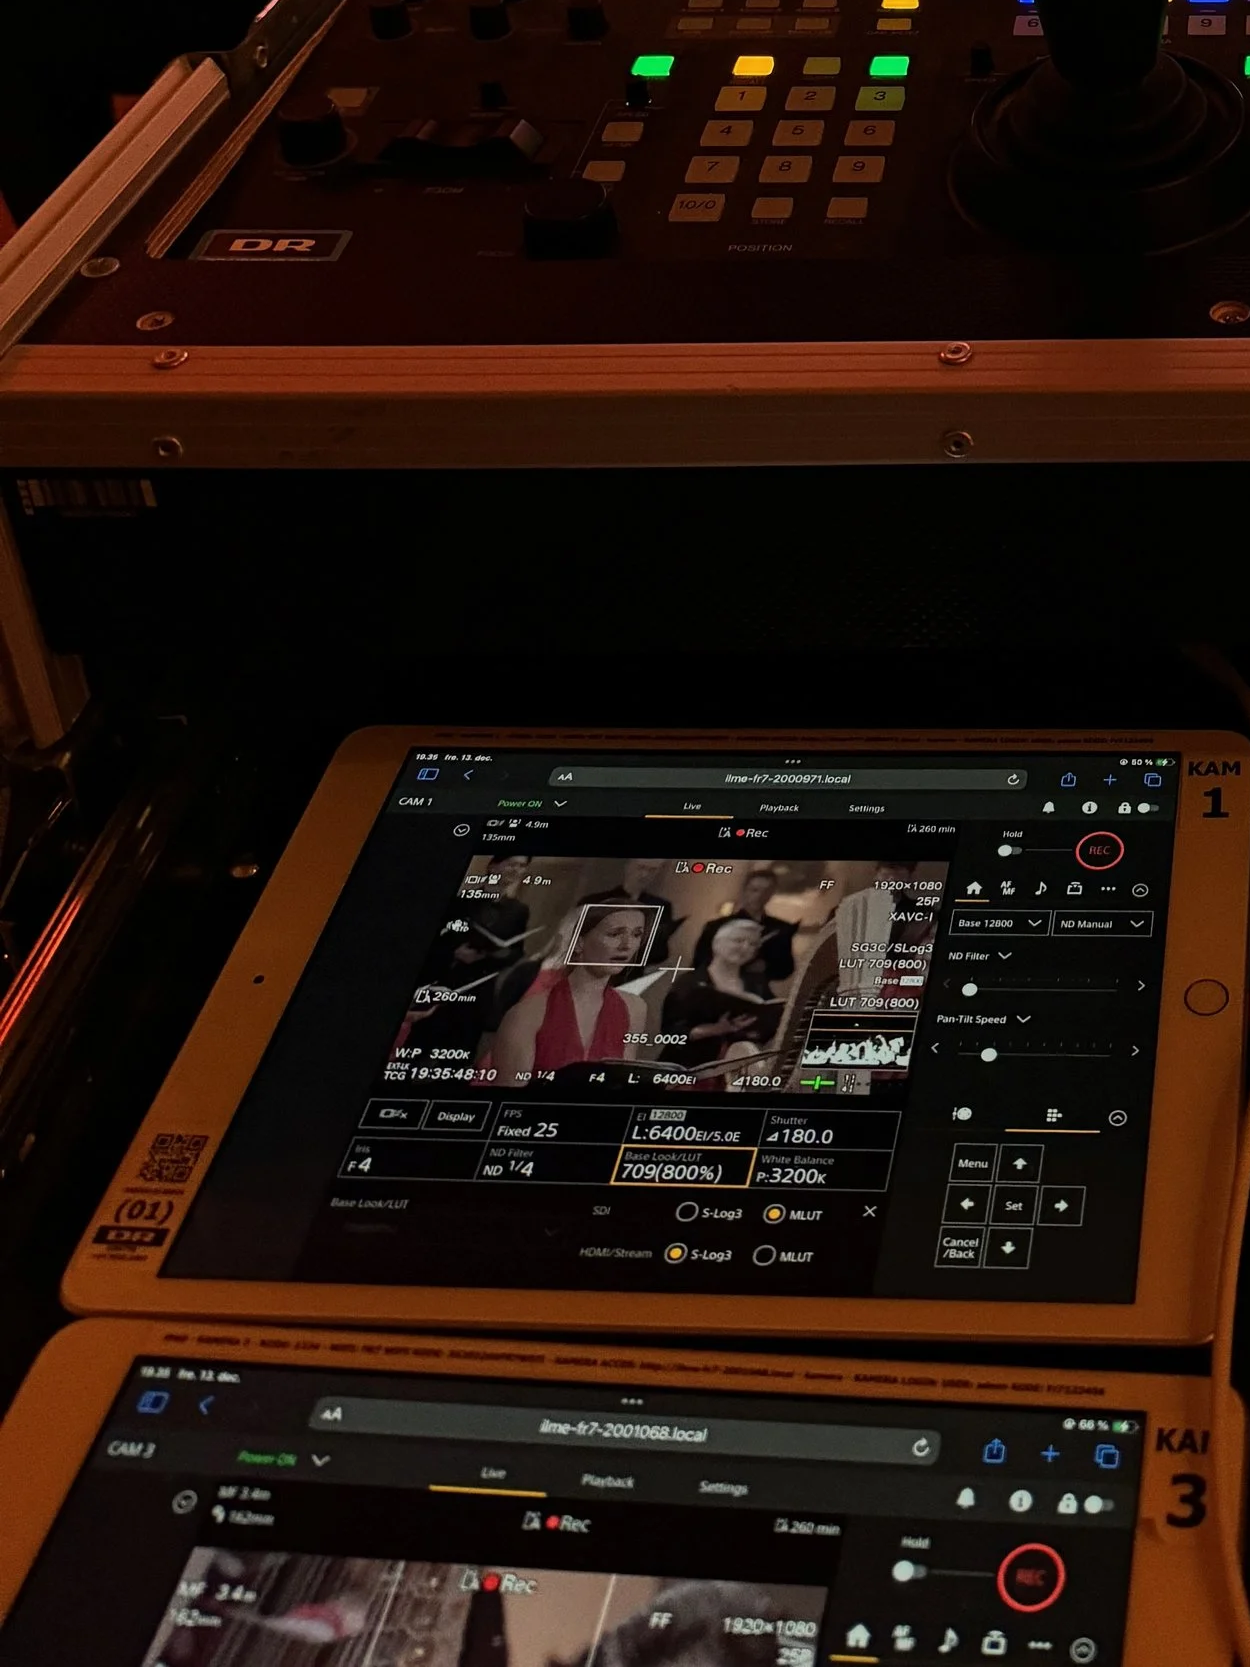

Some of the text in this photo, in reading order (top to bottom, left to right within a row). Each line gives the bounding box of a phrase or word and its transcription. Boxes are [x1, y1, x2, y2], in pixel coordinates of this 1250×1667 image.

[737, 92, 746, 101] 1
[804, 92, 817, 100] 2
[873, 92, 886, 100] 3
[720, 126, 733, 135] 4
[792, 126, 804, 135] 5
[864, 126, 876, 135] 6
[707, 162, 719, 172] 7
[779, 161, 792, 172] 8
[852, 161, 865, 172] 9
[679, 200, 716, 210] 10/0
[228, 238, 316, 252] DR
[728, 244, 793, 252] POSITION
[1188, 761, 1241, 776] KAM
[725, 773, 851, 786] ilme-fr7-2000971.local
[398, 797, 433, 806] CAM 1
[1202, 788, 1229, 818] 1
[759, 802, 799, 814] Playback
[849, 804, 885, 814] Settings
[746, 828, 768, 837] Rec
[1002, 830, 1023, 839] Hold
[705, 863, 732, 873] Rec
[820, 881, 835, 890] FF
[460, 890, 500, 900] 135mm
[916, 896, 940, 907] 25P
[958, 918, 1013, 929] Base 12800
[1061, 919, 1112, 929] ND Manual
[949, 951, 989, 961] ND Filter
[839, 959, 927, 971] LUT 709(800)
[830, 997, 919, 1009] LUT 709(800)
[623, 1034, 687, 1045] 355_0002
[383, 1067, 496, 1081] TCG 19:35:48:10
[437, 1111, 475, 1122] Display
[497, 1123, 558, 1137] Fixed 25
[483, 1161, 533, 1176] ND 1/4
[958, 1159, 988, 1169] Menu
[622, 1164, 722, 1182] 709(800%)
[1005, 1201, 1022, 1211] Set
[115, 1199, 174, 1225] (01)
[702, 1208, 742, 1219] S-Log3
[789, 1210, 822, 1220] MLUT
[943, 1237, 979, 1248] Cancel
[691, 1249, 732, 1261] S-Log3
[780, 1252, 814, 1262] MLUT
[108, 1440, 155, 1458] CAM 3
[582, 1474, 634, 1490] Playback
[700, 1481, 748, 1496] Settings
[1166, 1475, 1206, 1528] 3
[559, 1515, 591, 1532] Rec
[500, 1574, 537, 1594] Rec
